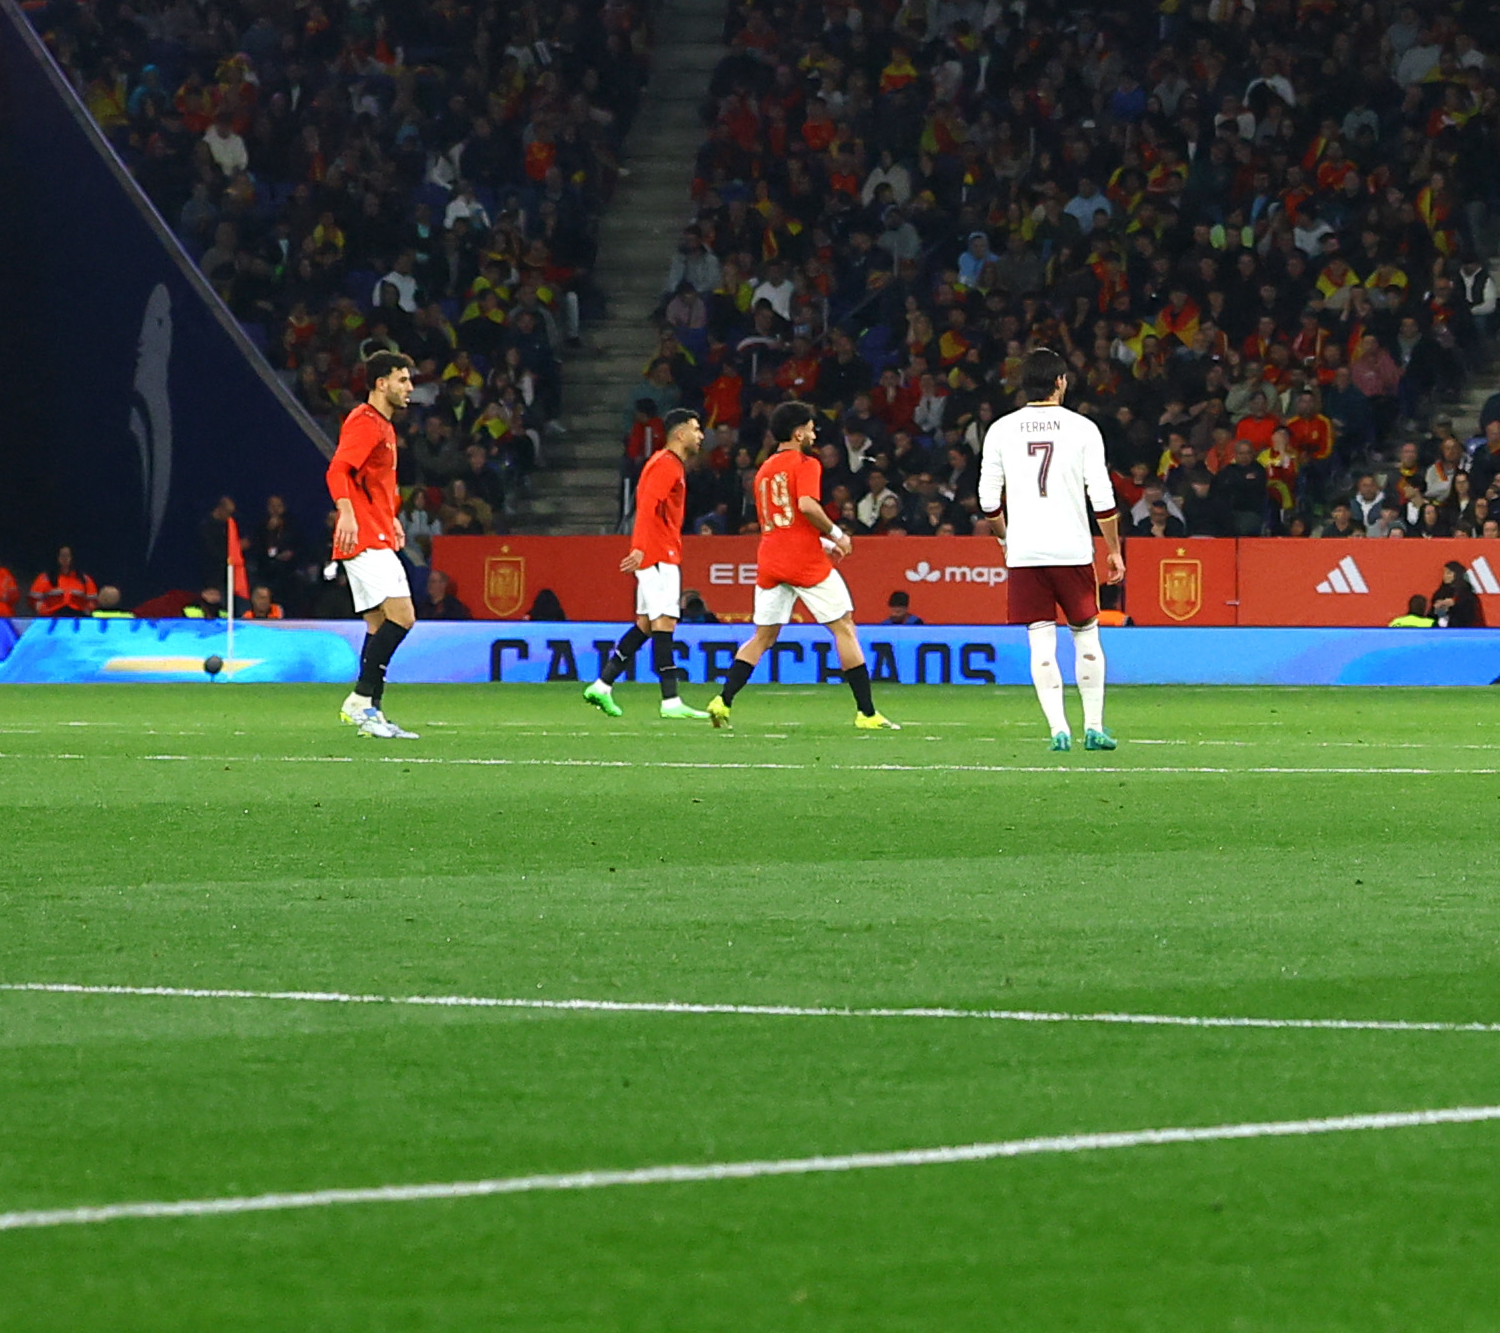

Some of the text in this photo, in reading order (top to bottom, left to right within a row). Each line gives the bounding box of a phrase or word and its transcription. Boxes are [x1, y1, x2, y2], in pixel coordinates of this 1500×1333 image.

[1019, 420, 1061, 433] FERRAN
[1027, 440, 1055, 498] 7
[758, 471, 794, 532] 19
